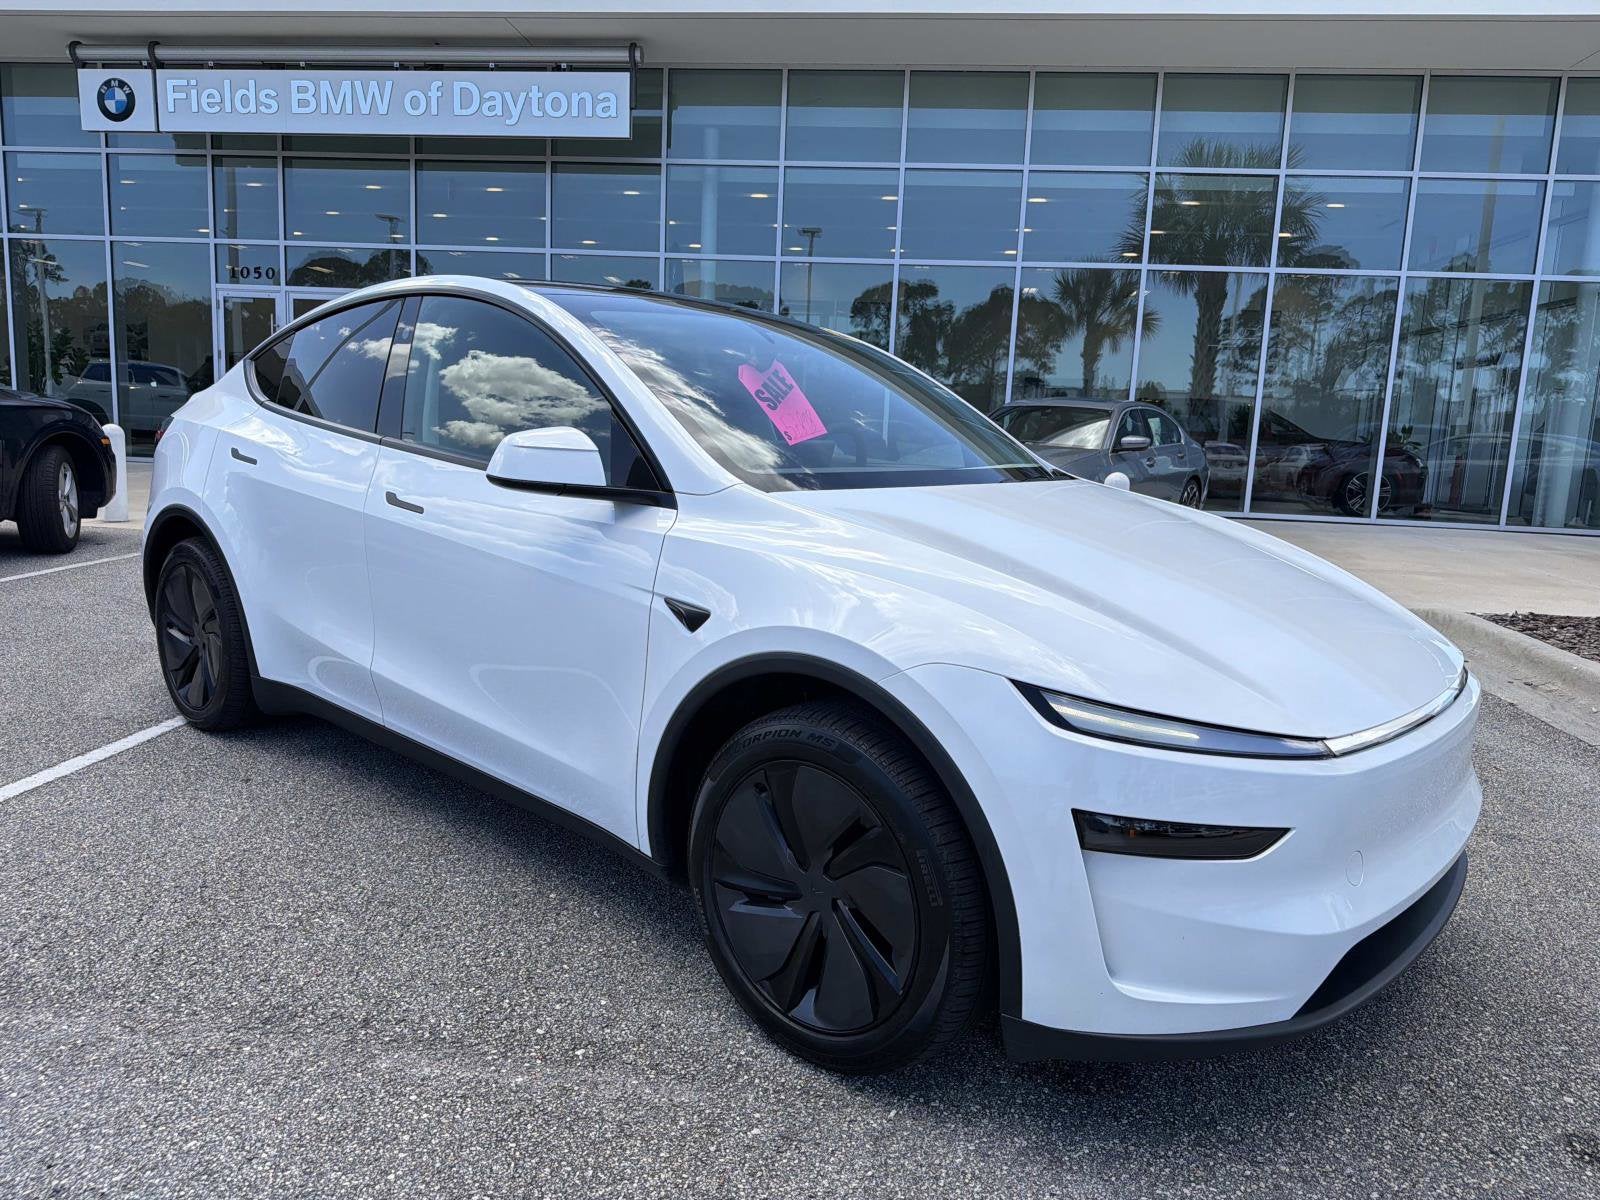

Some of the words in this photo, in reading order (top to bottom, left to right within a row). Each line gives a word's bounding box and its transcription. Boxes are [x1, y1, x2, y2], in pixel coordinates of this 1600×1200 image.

[100, 79, 132, 94] BMW
[165, 79, 279, 115] Fields
[290, 79, 393, 116] BMW
[403, 80, 443, 116] of
[453, 81, 618, 126] Daytona
[230, 266, 276, 280] 1050
[754, 369, 794, 411] SALE
[729, 729, 802, 753] ORPION
